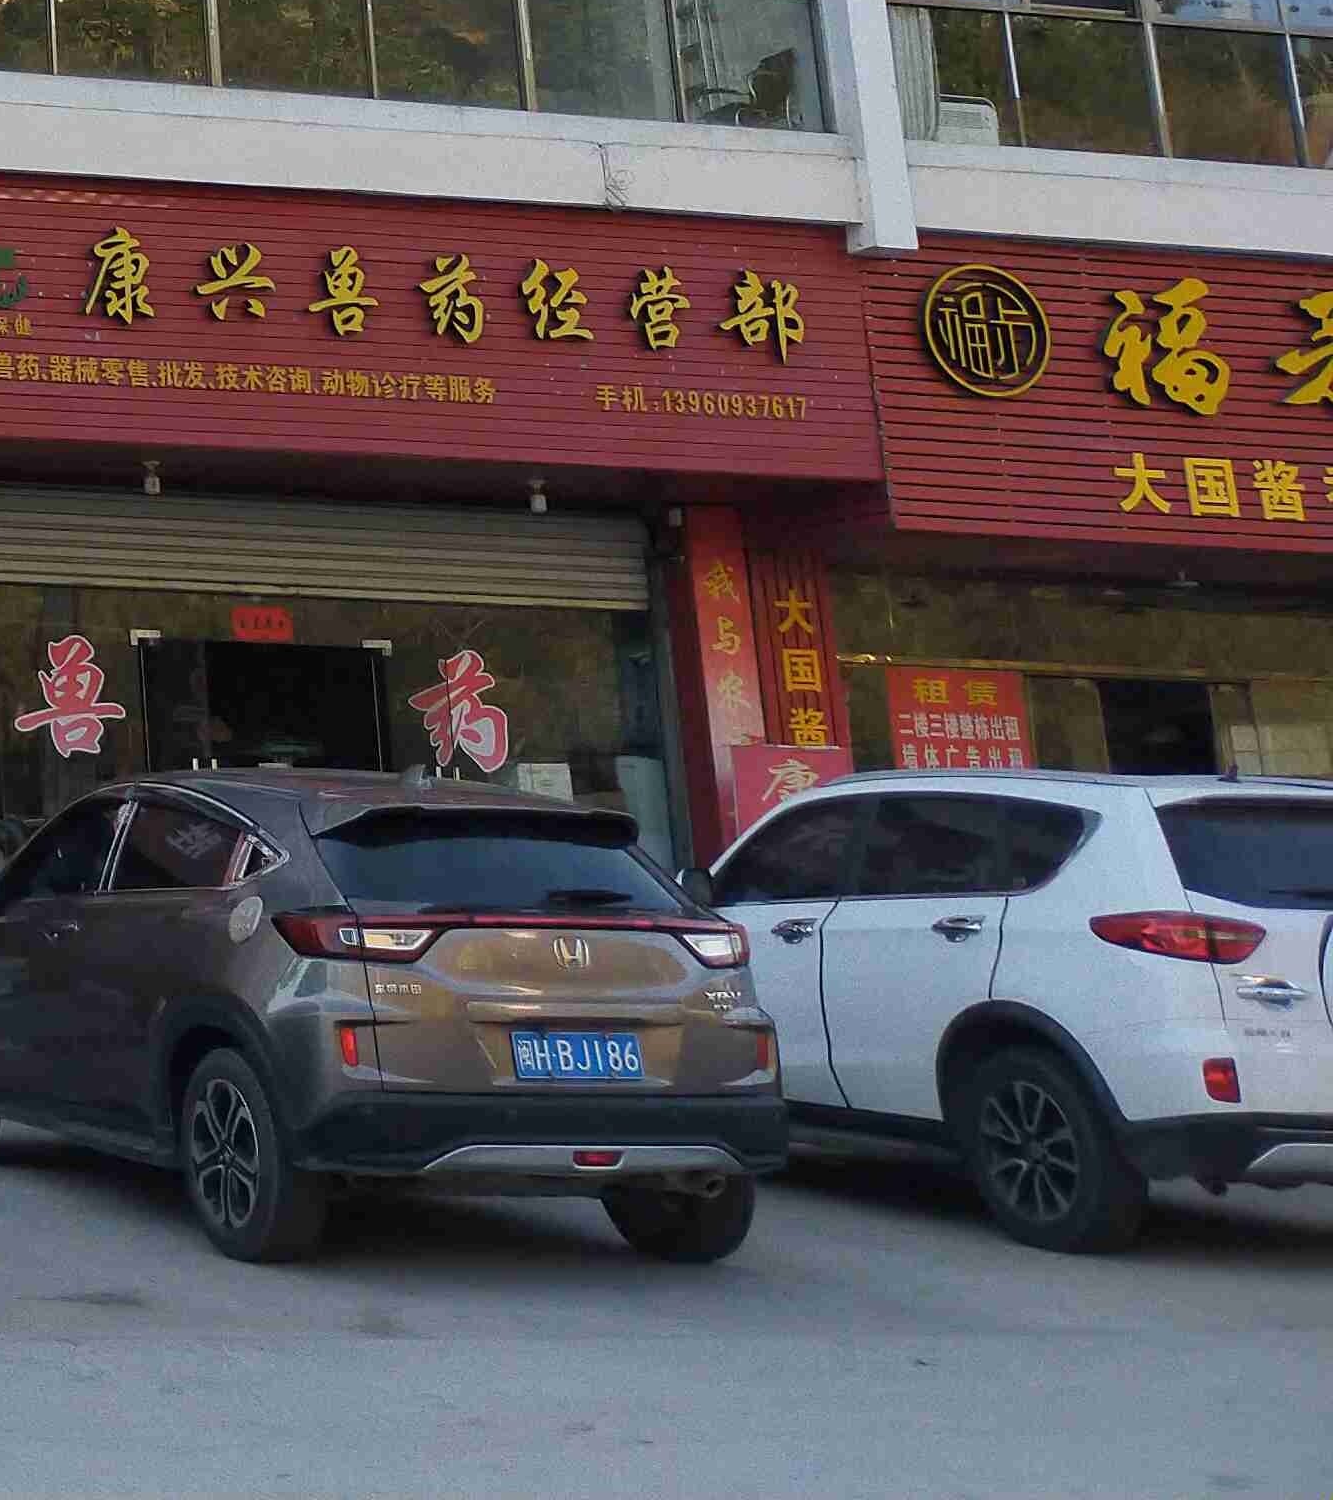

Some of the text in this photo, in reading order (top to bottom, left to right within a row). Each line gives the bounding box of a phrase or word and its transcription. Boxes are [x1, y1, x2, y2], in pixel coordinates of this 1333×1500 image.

[81, 226, 807, 362] 康兴兽药经营部
[1113, 452, 1333, 522] 大国酱
[15, 634, 126, 758] 兽
[408, 650, 510, 773] 药
[914, 676, 998, 707] 租赁
